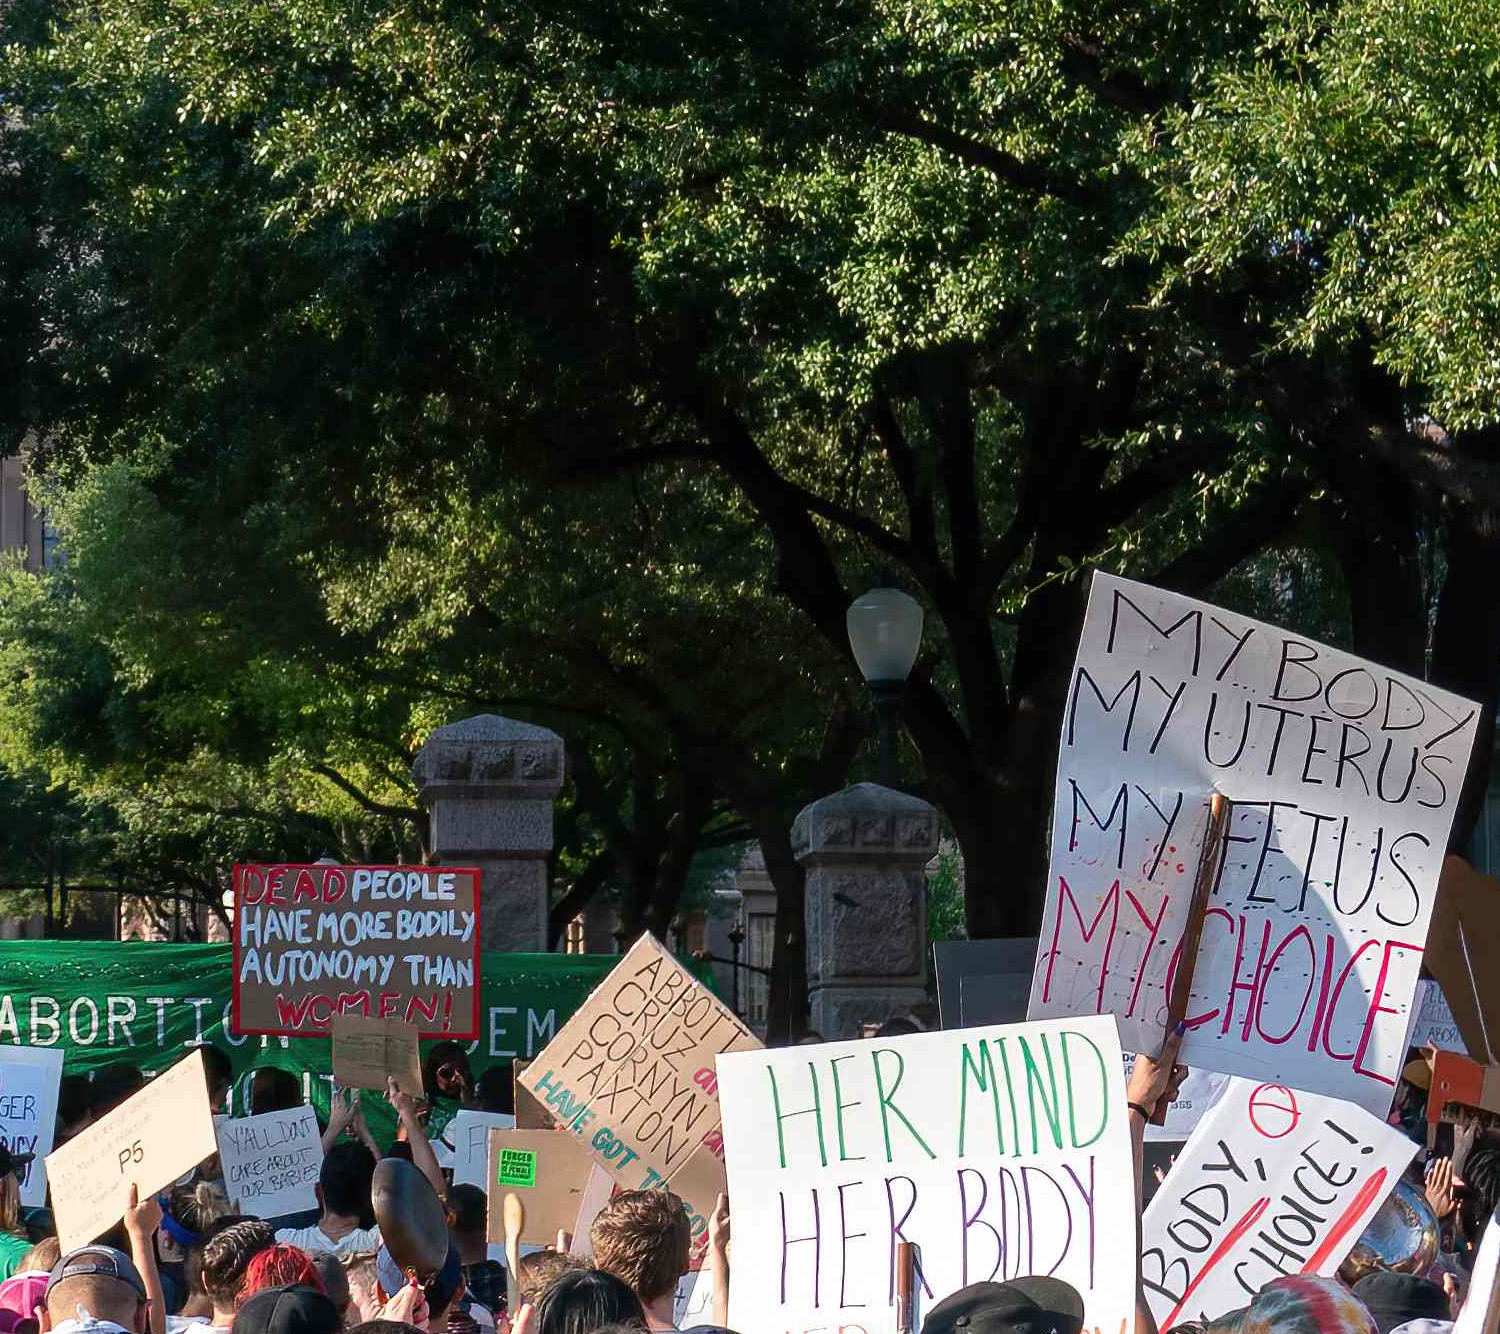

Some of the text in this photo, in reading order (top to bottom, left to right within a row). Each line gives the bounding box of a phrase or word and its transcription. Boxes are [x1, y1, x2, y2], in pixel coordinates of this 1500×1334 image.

[1108, 589, 1475, 751] MY BODY
[1068, 667, 1452, 809] MY UTERUS
[242, 868, 456, 904] DEAD PEOPLE
[1069, 778, 1431, 928] MY FETUS
[240, 949, 473, 988] AUTONOMY THAN
[241, 905, 475, 948] HAVE MORE BODILY
[1042, 876, 1425, 1087] MY CHOICE
[277, 990, 453, 1032] WOMEN!
[613, 982, 698, 1072] CRUZ
[635, 956, 749, 1053] ABBOTT
[535, 1070, 597, 1136] HAVE
[591, 1126, 639, 1172] GOT
[562, 1039, 689, 1165] PAXTON
[590, 1014, 707, 1132] CORNYN
[767, 1031, 1109, 1168] HER MIND
[118, 1140, 143, 1174] P5
[1234, 1119, 1375, 1295] CHOICE!
[780, 1156, 1096, 1309] HER BODY
